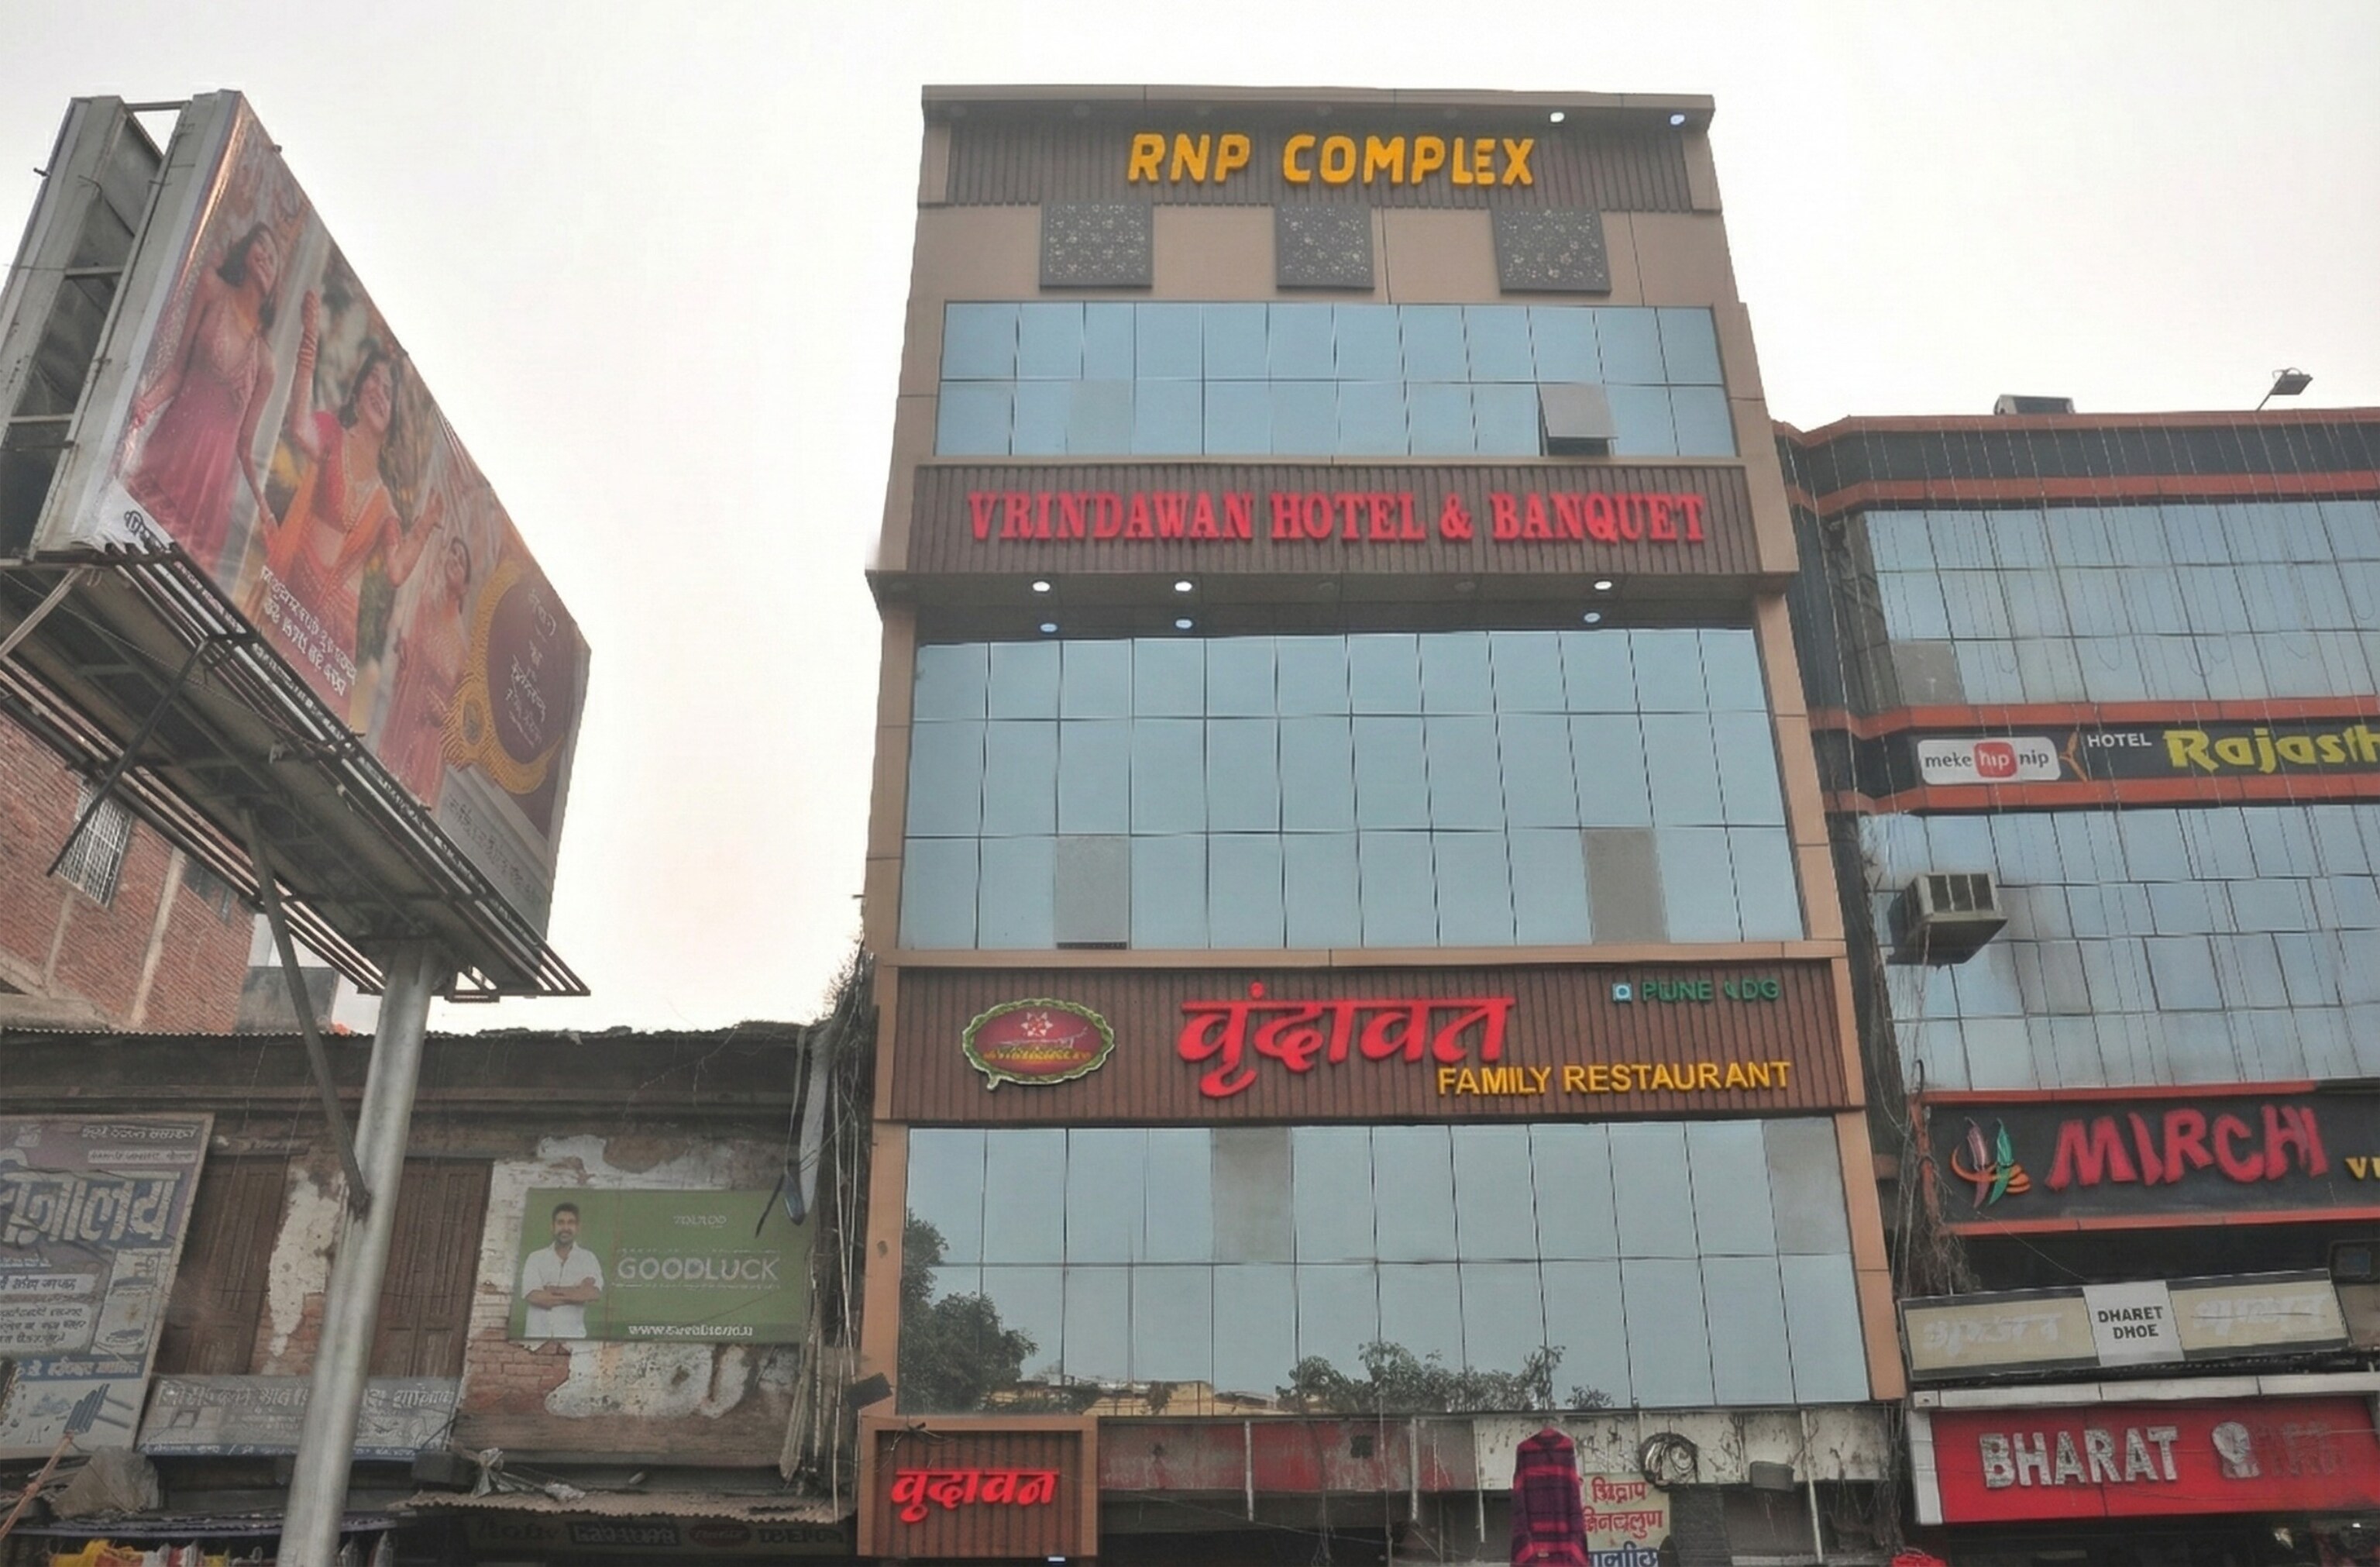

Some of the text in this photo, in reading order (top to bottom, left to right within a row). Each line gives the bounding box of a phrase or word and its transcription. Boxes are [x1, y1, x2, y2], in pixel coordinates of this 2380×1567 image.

[1127, 133, 1534, 186] RNP COMPLEX
[968, 491, 1704, 543] VRINDAWAN HOTEL & BANQUET
[2087, 732, 2152, 749] HOTEL
[1436, 1060, 1794, 1095] FAMILY RESTAURANT
[617, 1255, 780, 1281] GOODLUCK
[2097, 1306, 2163, 1324] DHARET
[1979, 1425, 2178, 1488] BHARAT
